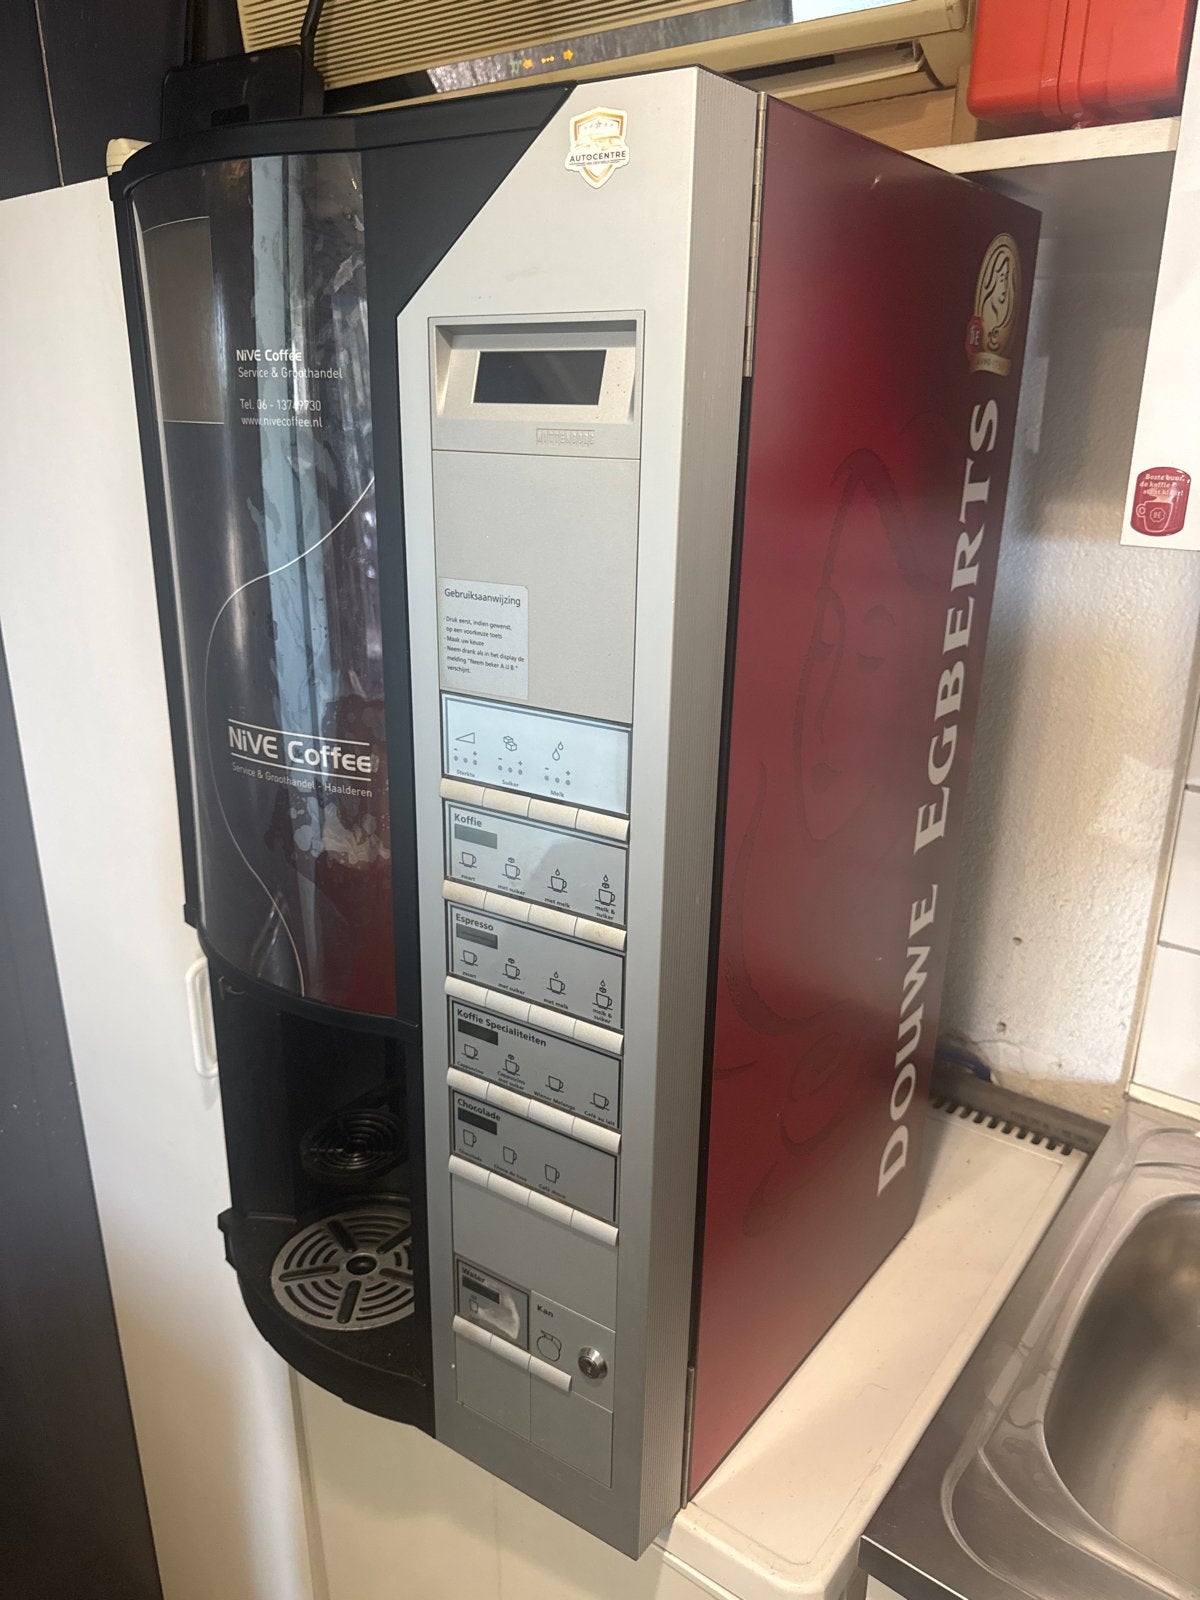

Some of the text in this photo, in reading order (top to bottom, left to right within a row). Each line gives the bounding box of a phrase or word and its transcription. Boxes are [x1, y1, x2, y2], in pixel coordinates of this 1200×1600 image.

[569, 151, 626, 162] AUTOCENTRE
[236, 349, 303, 362] NiVE Coffee
[238, 367, 343, 379] Service & Groothandel
[240, 399, 254, 410] Tel.
[257, 399, 268, 410] 06
[241, 416, 323, 428] www.nivecoffee.nl
[444, 588, 520, 608] Gebruiksaanwijzing
[447, 655, 466, 664] melding
[500, 653, 517, 662] display
[228, 725, 371, 773] NiVE Coffee
[456, 769, 476, 778] Sterkte
[232, 762, 255, 777] Service
[257, 770, 263, 778] &
[265, 771, 315, 790] Groothandel
[324, 783, 372, 798] Haalderen
[502, 779, 519, 788] Suiker
[551, 790, 564, 798] Melk
[877, 399, 998, 1197] DOUWE EGBERTS
[454, 813, 482, 828] Koffie
[509, 886, 525, 896] suiker
[557, 900, 570, 909] melk
[456, 913, 494, 932] Espresso
[556, 1001, 569, 1010] melk
[457, 1008, 547, 1047] Koffie Specialiteiten
[457, 1098, 501, 1121] Chocolade
[606, 1117, 615, 1127] lait
[462, 1267, 486, 1283] Water
[537, 1304, 554, 1318] Kan
